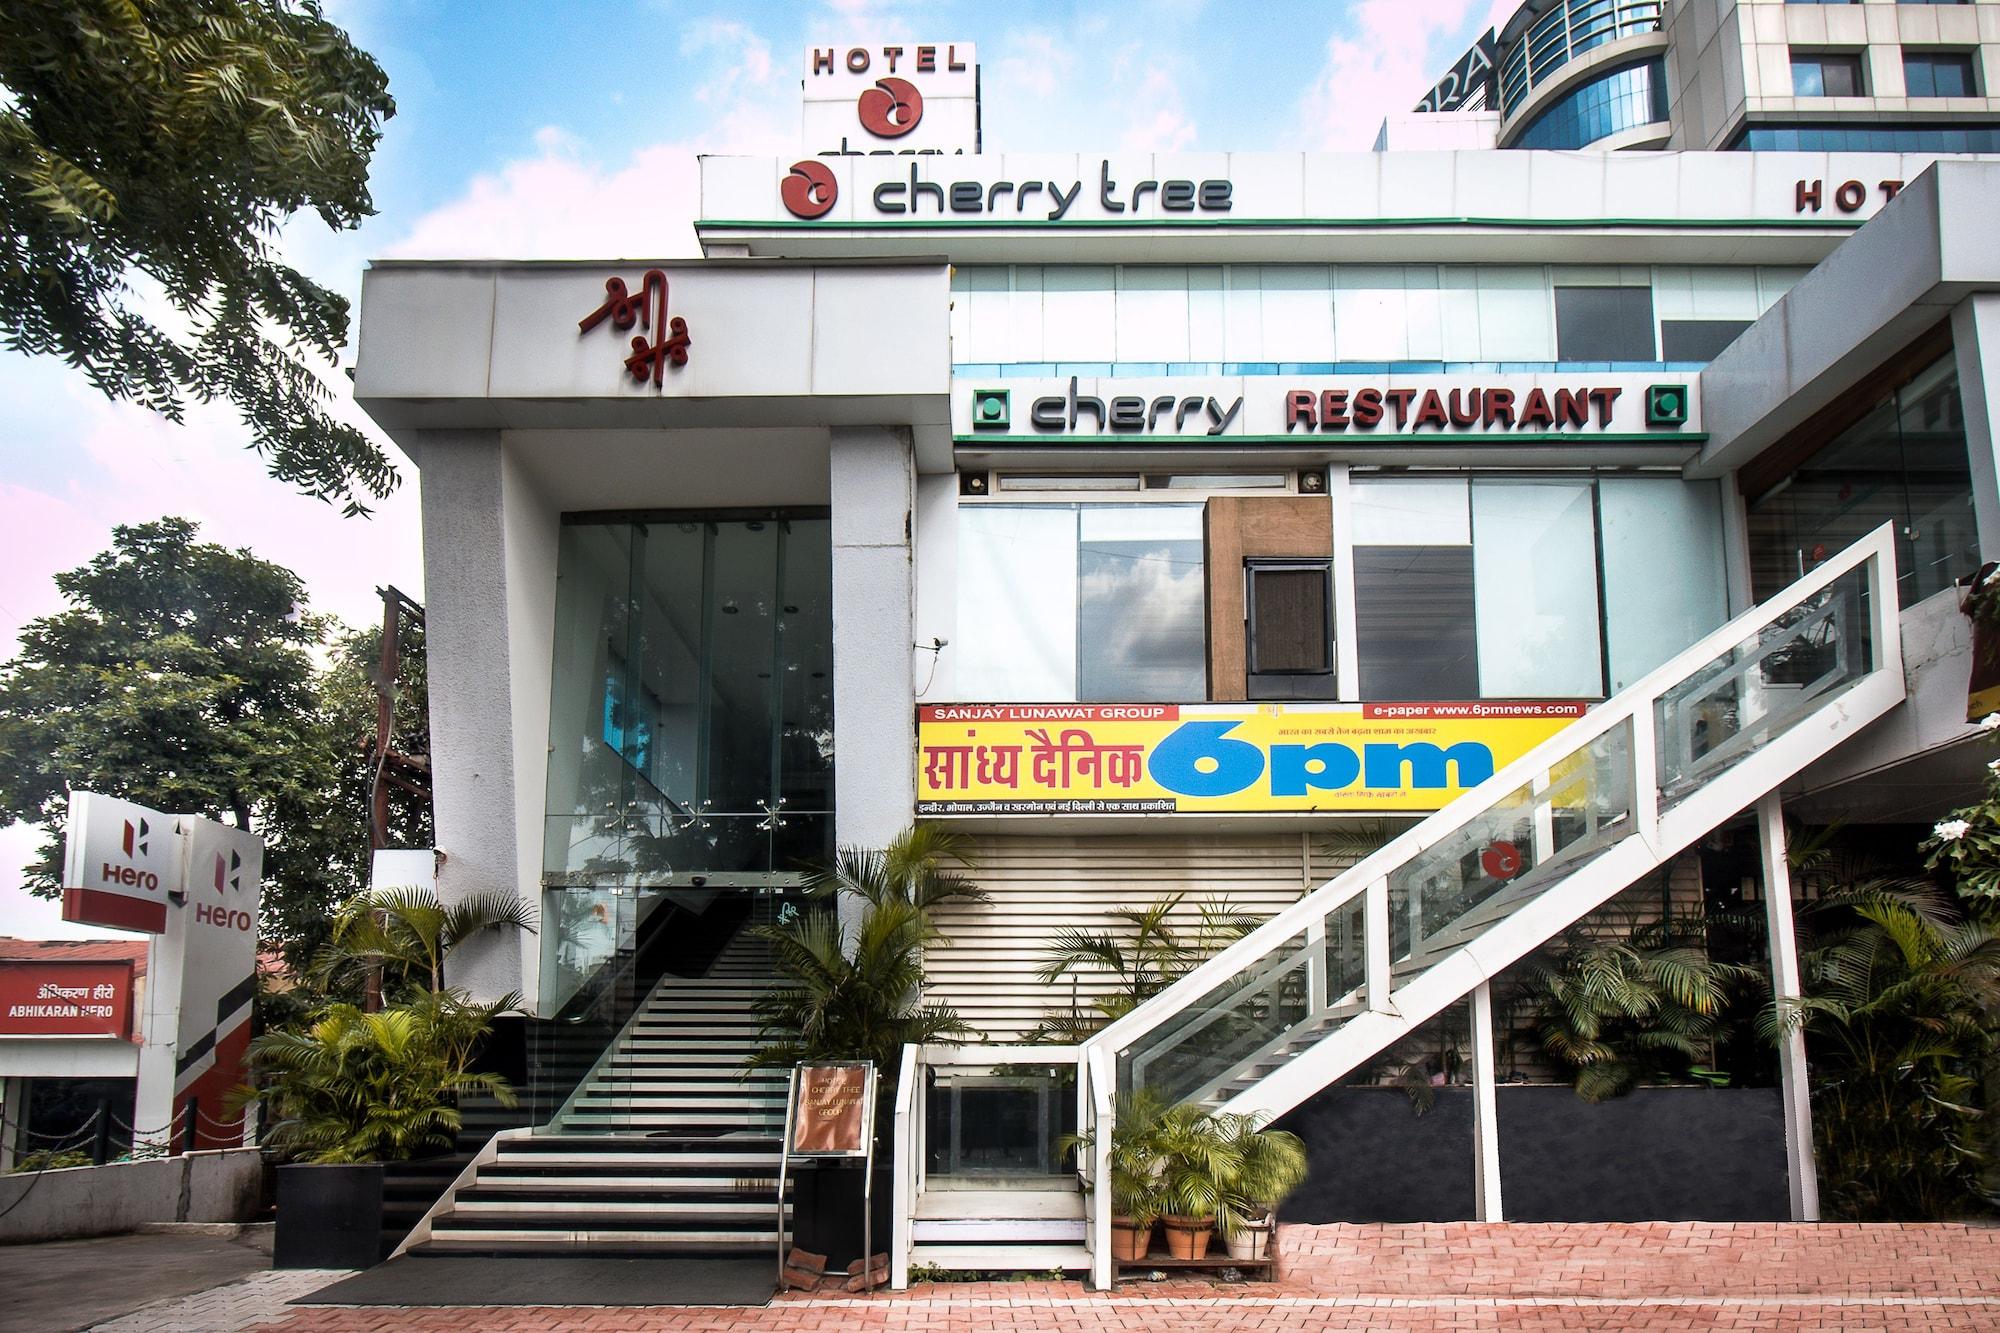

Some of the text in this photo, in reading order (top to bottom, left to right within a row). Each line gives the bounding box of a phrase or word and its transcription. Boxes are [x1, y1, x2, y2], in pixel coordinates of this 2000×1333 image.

[813, 44, 966, 74] HOTEL
[872, 159, 1233, 220] cherry tree
[1030, 376, 1624, 436] cherry RESTAURANT
[934, 707, 1165, 719] SANJAY LUNAWAT GROUP
[1374, 703, 1578, 716] e-paper www.6pmnews.com
[1025, 729, 1145, 788] दैनिक
[1147, 719, 1495, 797] 6pm
[102, 863, 158, 890] Hero
[196, 903, 251, 931] Hero
[93, 984, 115, 999] हीरो
[9, 1006, 78, 1017] ABHIKARAN
